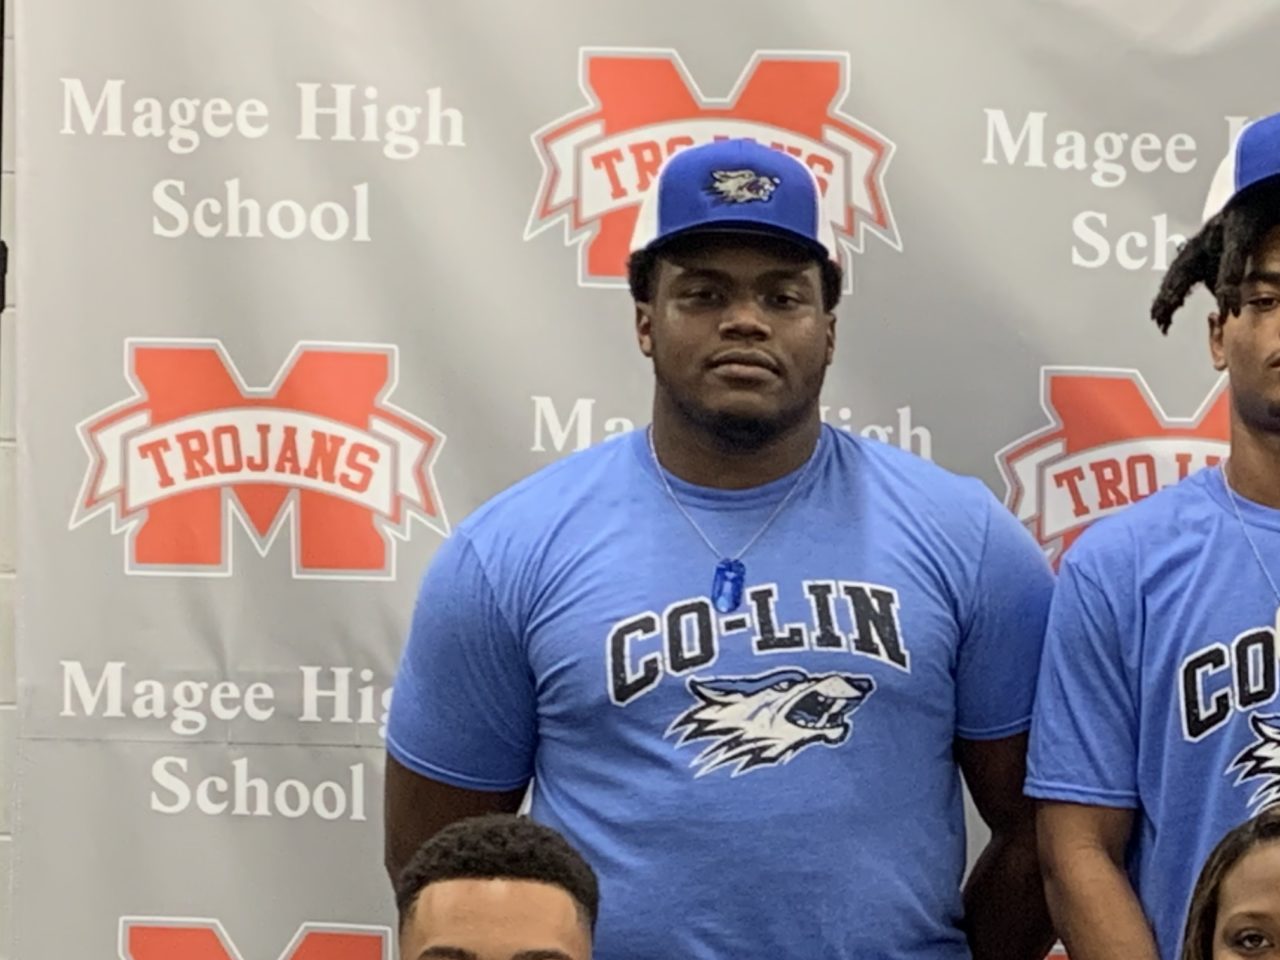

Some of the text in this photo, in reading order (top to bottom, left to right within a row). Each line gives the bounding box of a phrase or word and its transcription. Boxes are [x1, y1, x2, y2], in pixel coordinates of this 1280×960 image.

[59, 77, 466, 160] Magee High
[982, 108, 1197, 187] Magee
[152, 178, 371, 242] School
[1071, 211, 1191, 270] Sch
[138, 424, 381, 493] TROJANS
[606, 579, 912, 708] CO-LIN
[59, 660, 275, 736] Magee
[150, 756, 366, 821] School
